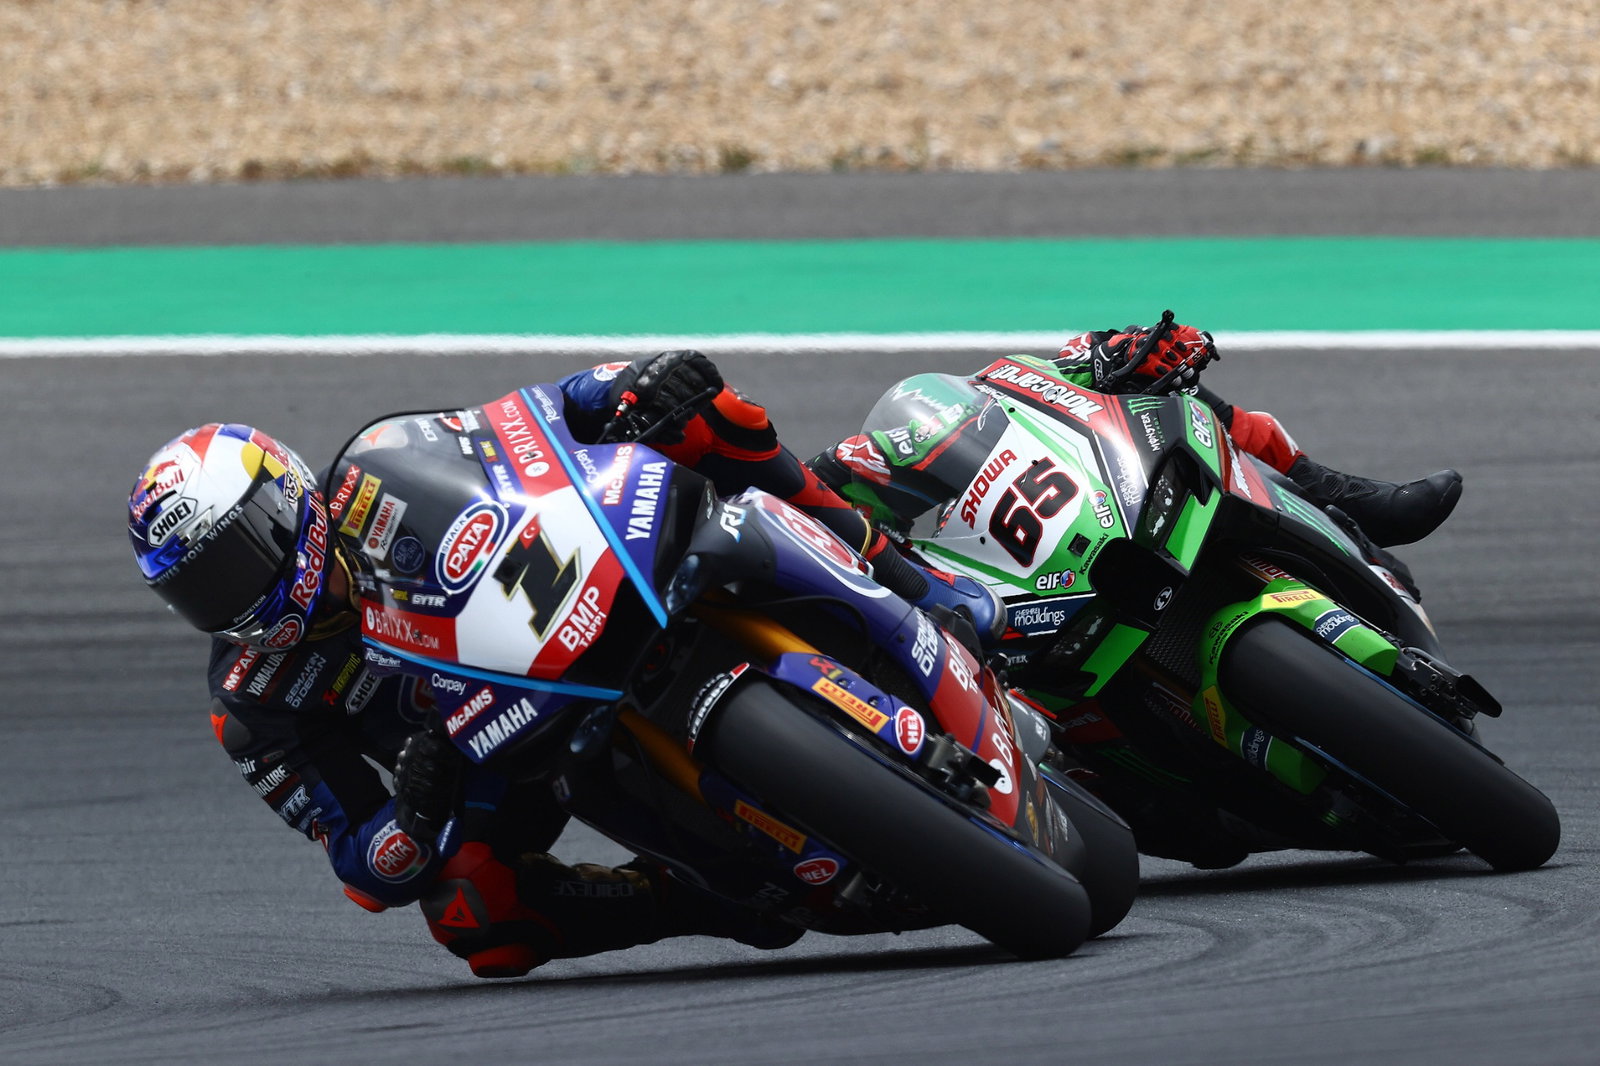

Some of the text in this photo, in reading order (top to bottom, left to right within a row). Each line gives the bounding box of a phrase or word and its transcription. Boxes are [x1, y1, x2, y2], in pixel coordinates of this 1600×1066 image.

[330, 465, 360, 517] BRIXX
[625, 461, 667, 541] YAMAHA
[960, 449, 1017, 530] SHOWA
[151, 501, 192, 543] SHOEI
[182, 543, 204, 560] YOU
[206, 504, 244, 542] WINGS
[372, 500, 396, 538] YAMAHA
[989, 456, 1079, 568] 65
[290, 494, 328, 610] Red Bull
[452, 520, 491, 574] PATA
[1079, 533, 1110, 576] Kawasaki
[412, 593, 447, 608] GYTR
[493, 515, 583, 643] 1
[1035, 572, 1062, 591] elf
[1269, 590, 1317, 604] PIRELLI
[557, 586, 601, 652] BMP
[577, 611, 608, 648] TAPPI
[1014, 606, 1066, 627] mouldings
[431, 673, 467, 696] Corpay
[819, 682, 883, 728] PIRELLI
[446, 689, 494, 735] McAMS
[468, 697, 539, 759] YAMAHA
[907, 714, 919, 745] HEL
[376, 838, 414, 873] PATA
[801, 866, 833, 882] HEL
